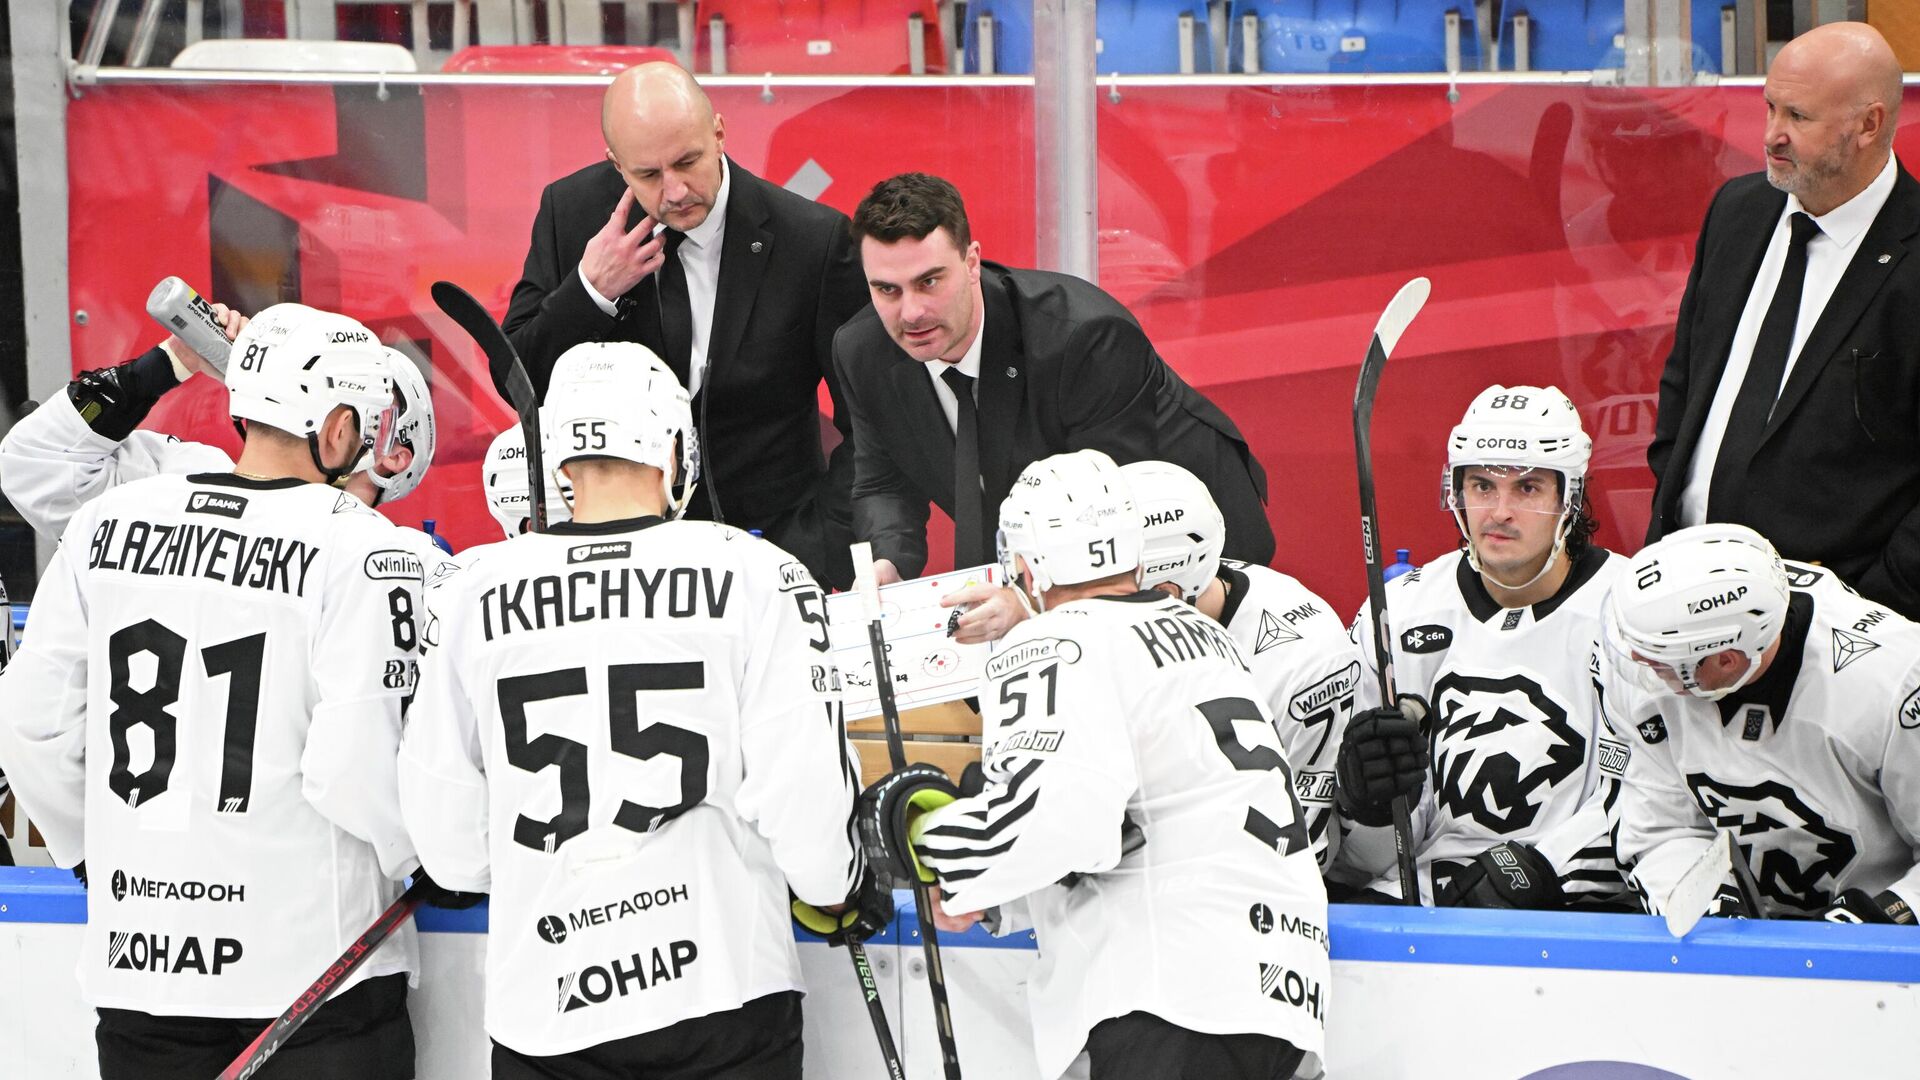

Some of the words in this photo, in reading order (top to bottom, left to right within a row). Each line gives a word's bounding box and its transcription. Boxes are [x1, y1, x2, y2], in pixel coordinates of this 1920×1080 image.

[240, 344, 269, 373] 81
[338, 381, 366, 391] CCM
[1490, 395, 1529, 409] 88
[572, 421, 606, 451] 55
[1476, 438, 1527, 450] согаз
[207, 497, 241, 511] БАНК
[591, 543, 627, 554] БАНК
[1088, 537, 1117, 568] 51
[1363, 520, 1373, 560] CCM
[89, 519, 320, 598] BLAZHIYEVSKY
[1147, 560, 1184, 574] CCM
[1636, 559, 1662, 590] 10
[480, 567, 734, 642] TKACHYOV
[1283, 602, 1322, 626] РМК
[1688, 586, 1748, 615] КОНАР
[992, 645, 1050, 673] Winline
[1694, 638, 1734, 652] CCM
[1000, 662, 1058, 727] 51
[1296, 678, 1350, 713] Winline
[109, 618, 267, 813] 81
[497, 661, 709, 854] 55
[131, 876, 245, 902] МЕГАФОН
[568, 884, 689, 932] МЕГАФОН
[108, 931, 243, 975] КОНАР
[291, 935, 369, 1014] JETSPEED
[557, 939, 698, 1014] КОНАР
